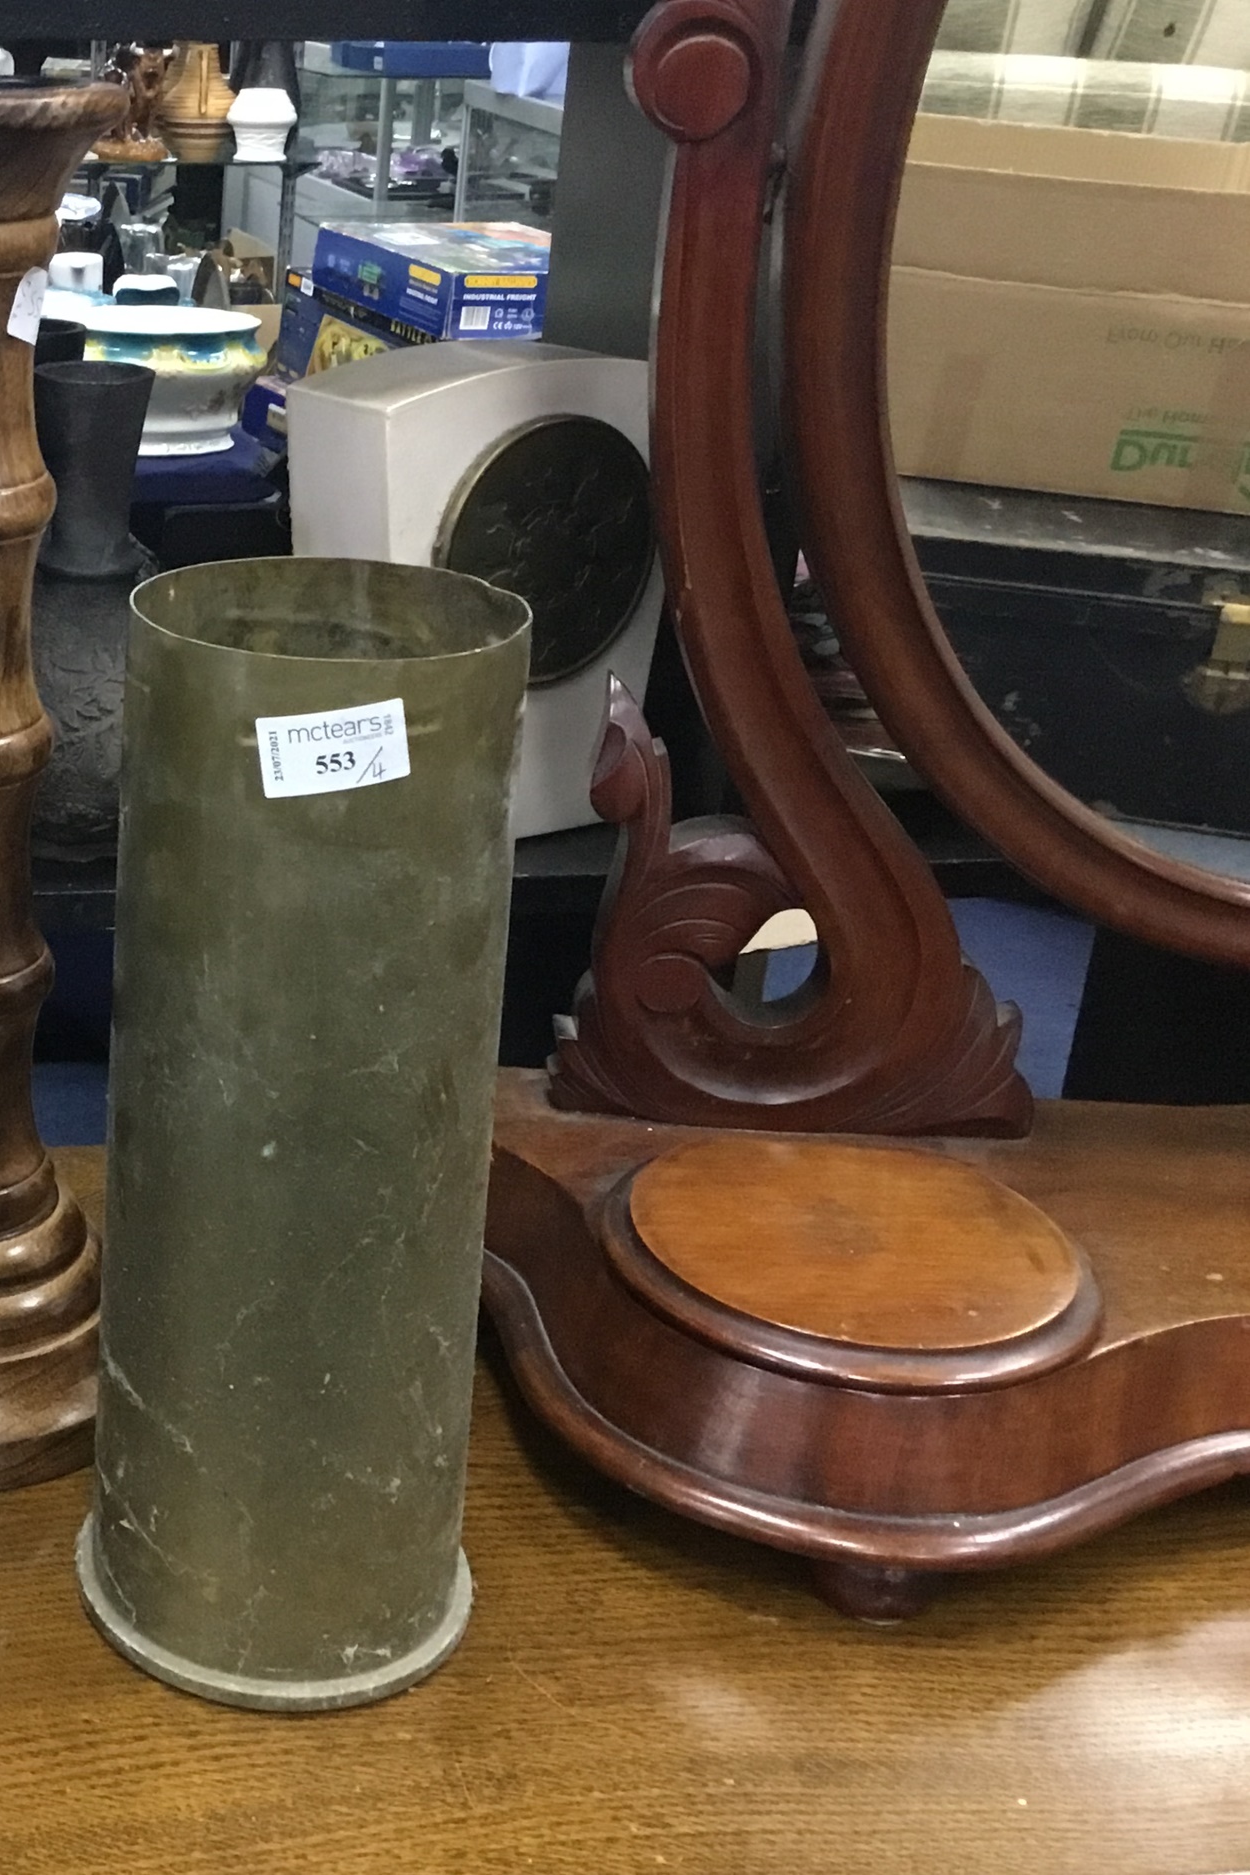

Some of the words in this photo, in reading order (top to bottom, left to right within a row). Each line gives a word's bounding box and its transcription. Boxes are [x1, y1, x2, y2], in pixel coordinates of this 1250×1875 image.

[462, 293, 505, 301] INDUSTRIAL
[507, 293, 537, 301] FREIGHT
[268, 731, 284, 781] 23/07/2021
[315, 751, 356, 774] 553
